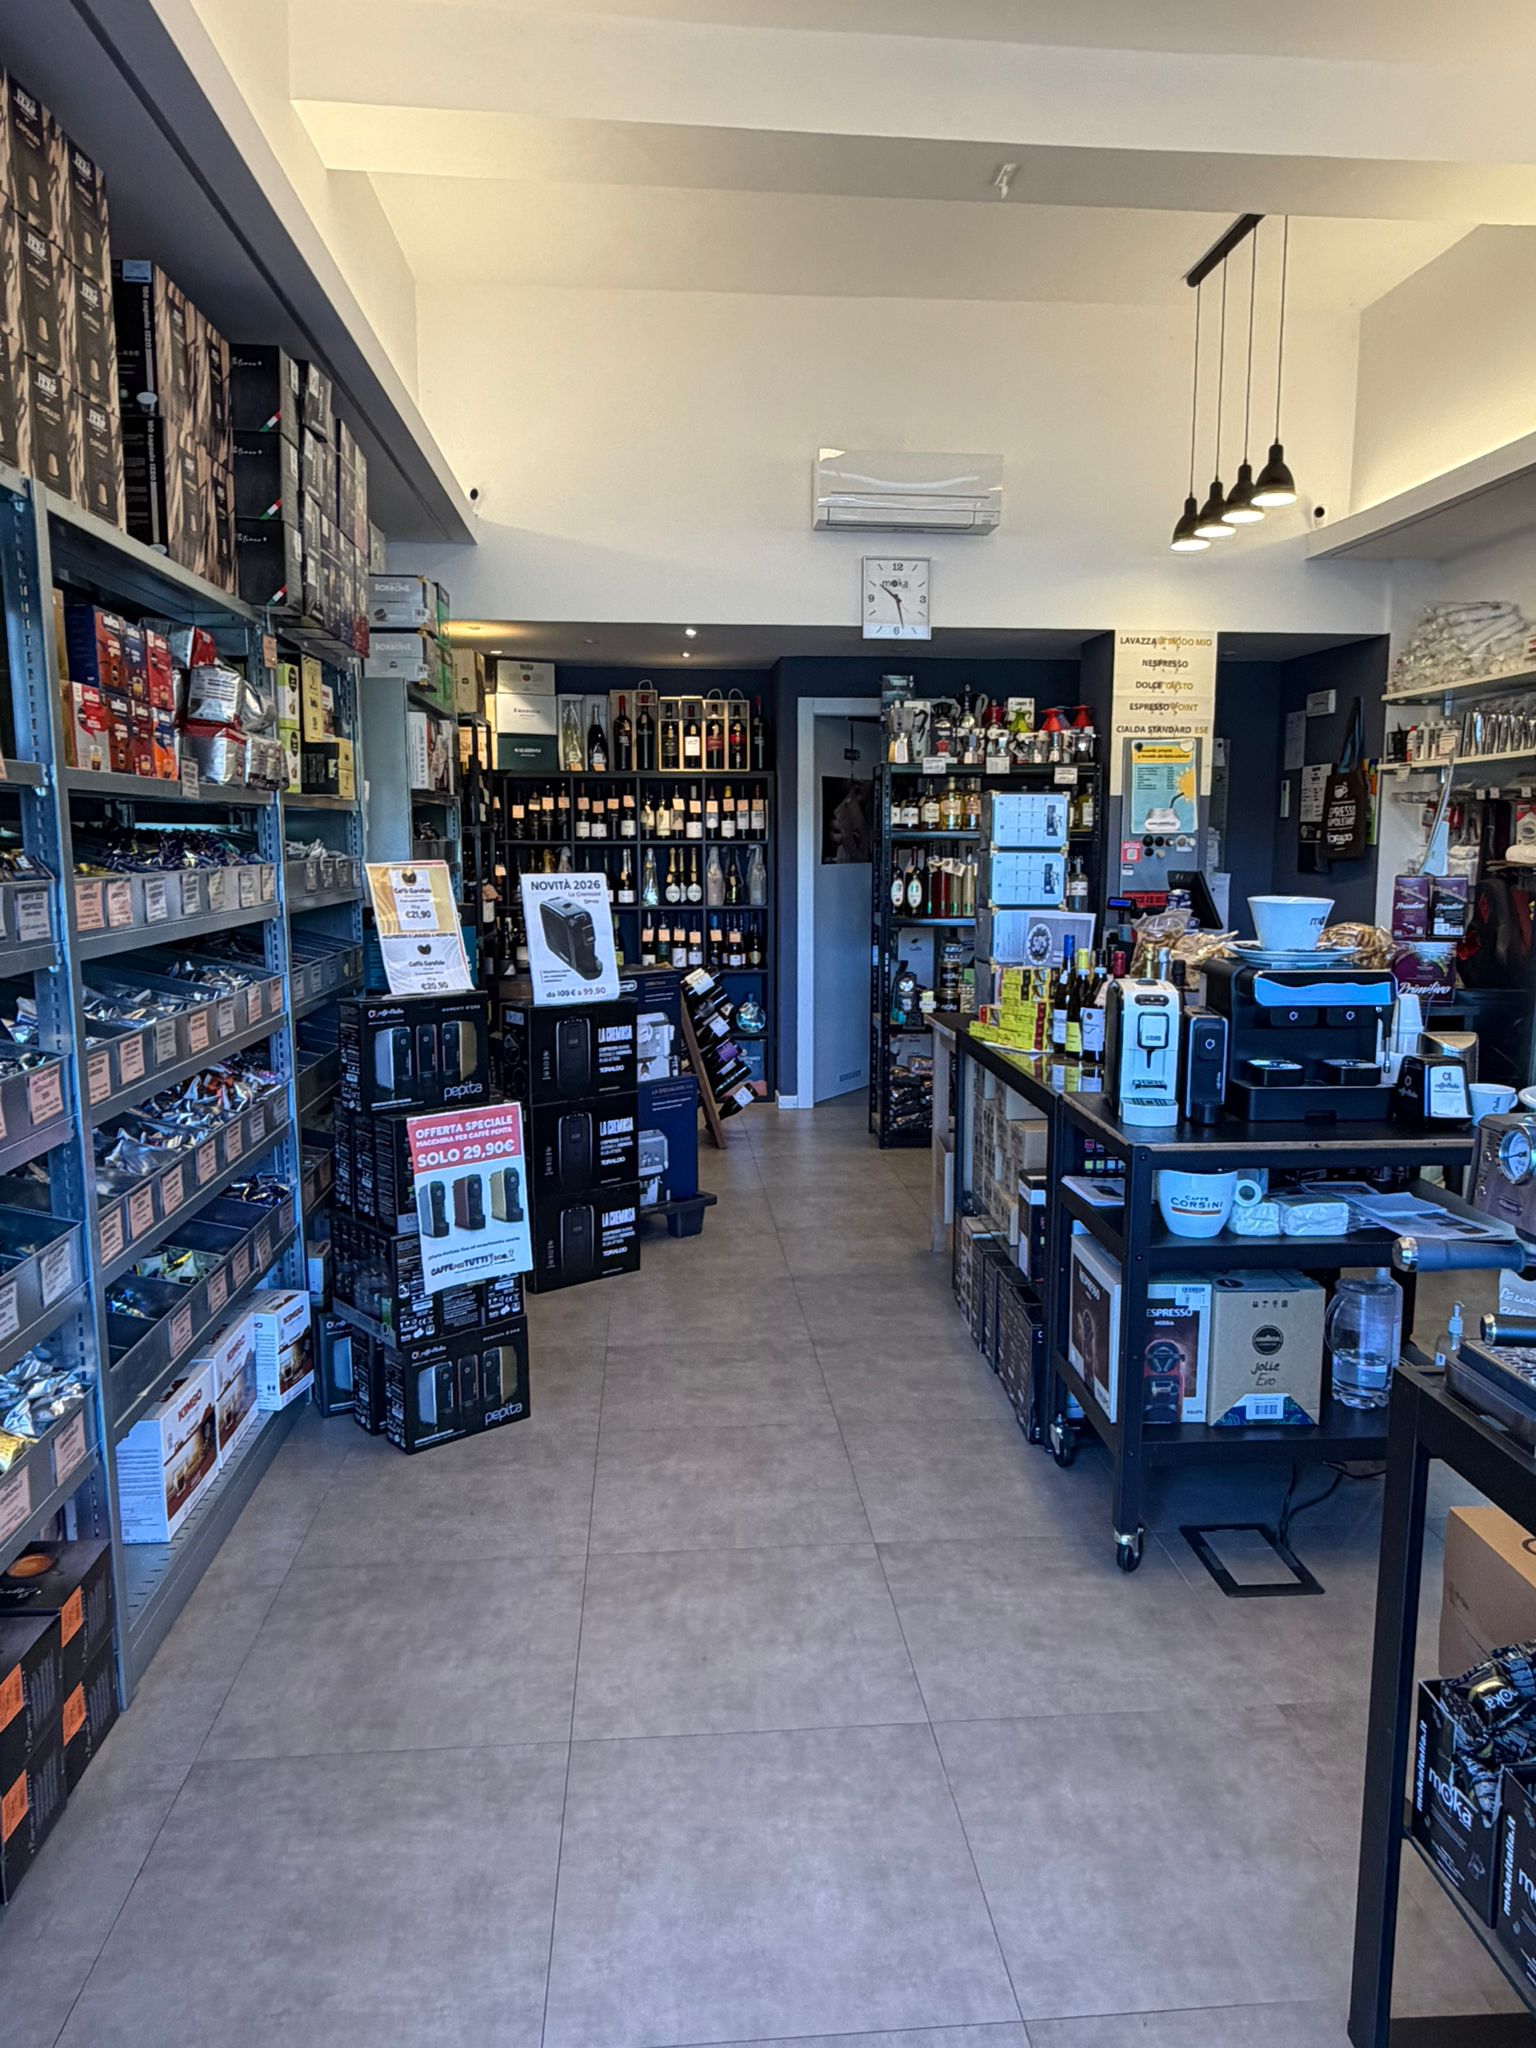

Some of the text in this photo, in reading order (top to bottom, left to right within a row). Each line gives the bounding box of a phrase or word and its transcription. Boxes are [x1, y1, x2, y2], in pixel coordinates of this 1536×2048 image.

[892, 563, 904, 571] 12
[867, 594, 875, 603] 9
[919, 595, 927, 604] 3
[893, 626, 900, 635] 6
[1120, 637, 1157, 646] LAVAZZA
[1196, 638, 1213, 646] MIO
[1142, 659, 1189, 668] NESPRESSO
[1135, 681, 1194, 690] DOLCE GUSTO
[1129, 702, 1170, 711] ESPRESSO
[1116, 725, 1209, 734] CIALDA STANDARD ESE
[531, 879, 601, 891] NOVITÀ 2026
[1398, 980, 1452, 995] Primitivo
[546, 990, 556, 998] da
[444, 1081, 483, 1101] pepita
[415, 1115, 513, 1139] OFFERTA SPECIALE
[416, 1136, 454, 1148] MACCHINA
[491, 1126, 513, 1136] PEPITA
[417, 1139, 515, 1168] SOLO 29,90€
[1171, 1197, 1223, 1209] CORSINI
[283, 1304, 304, 1326] KIMBO
[1146, 1308, 1193, 1318] ESPRESSO
[177, 1388, 203, 1423] KIMBO
[484, 1400, 523, 1426] pepita
[1416, 1719, 1428, 1812] mokaitalia.it
[1428, 1766, 1473, 1830] moka
[1502, 1814, 1517, 1917] mokaitalia.it
